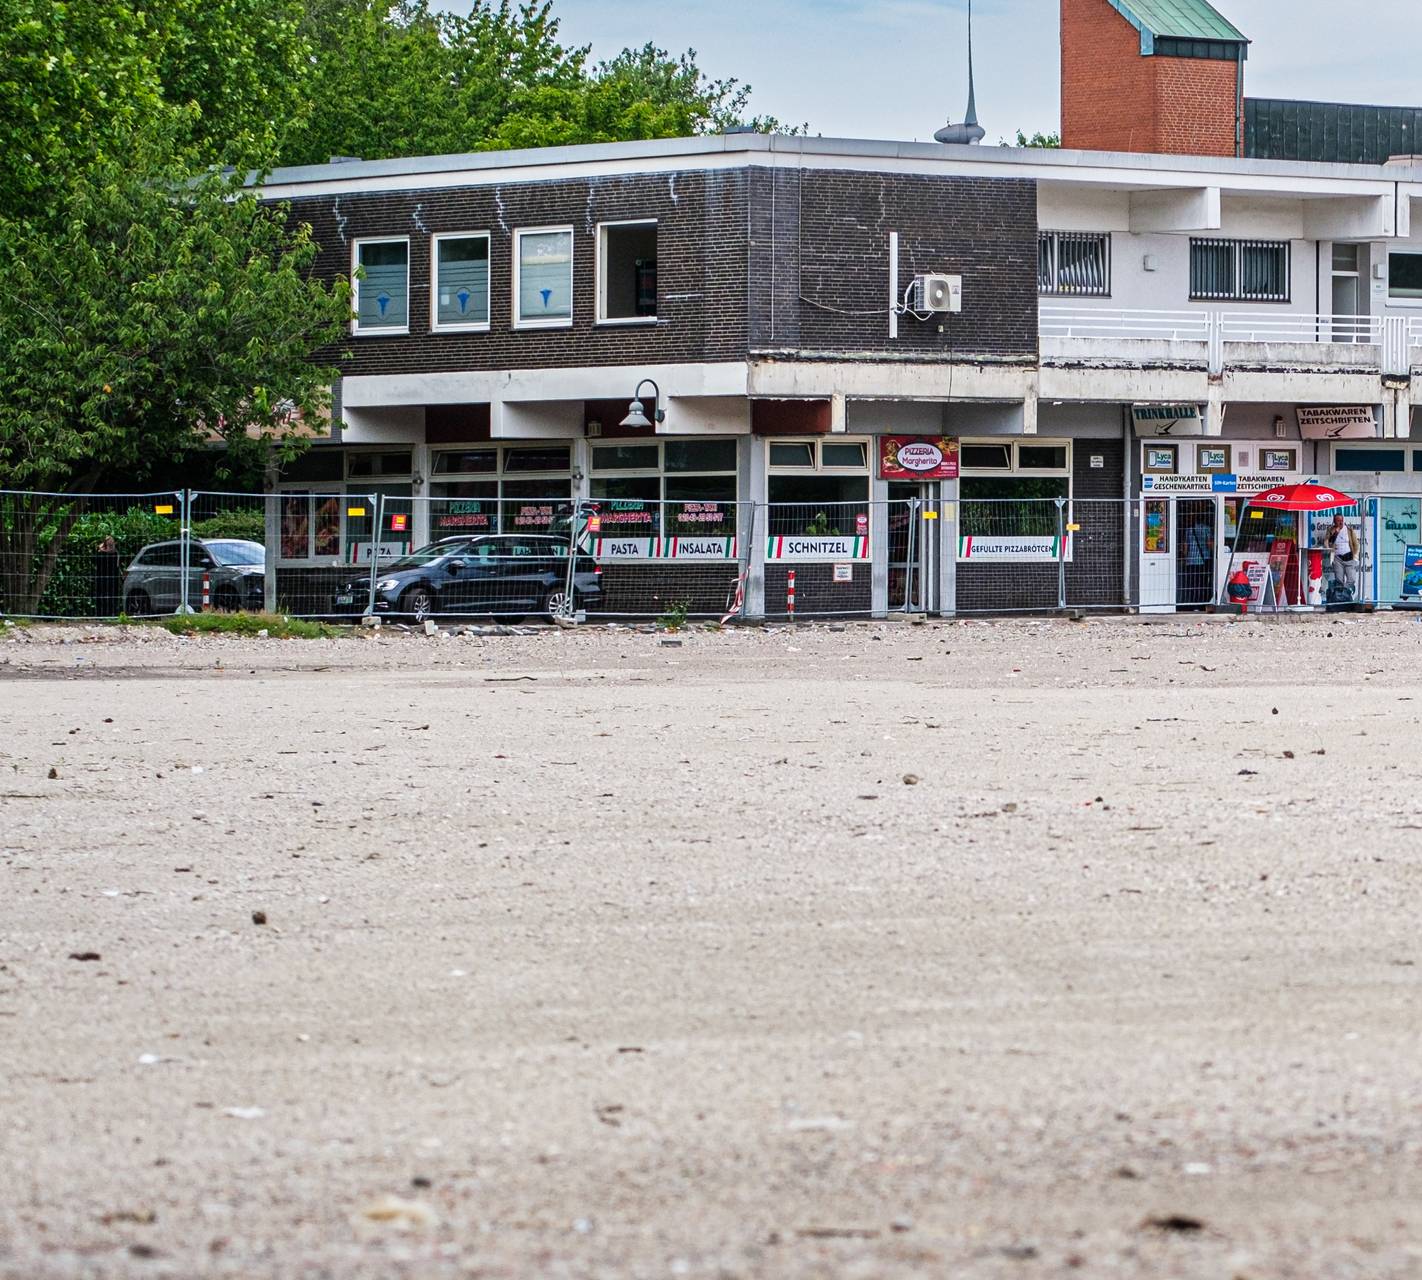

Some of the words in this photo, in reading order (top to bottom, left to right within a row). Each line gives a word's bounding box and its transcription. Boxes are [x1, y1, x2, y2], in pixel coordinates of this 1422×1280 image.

[1135, 406, 1196, 419] TRINKHALLE
[1301, 408, 1366, 416] TABAKWAREN
[1300, 416, 1371, 424] ZEITSCHRIFTEN
[904, 447, 934, 456] PIZZERIA
[1157, 452, 1171, 461] Lyca
[1210, 451, 1224, 460] Lyca
[1274, 452, 1288, 462] Lyca
[600, 512, 652, 523] MARGHERITA
[611, 544, 638, 554] PASTA
[679, 544, 722, 554] INSALATA
[788, 542, 848, 553] SCHNITZEL
[367, 548, 392, 558] PZA
